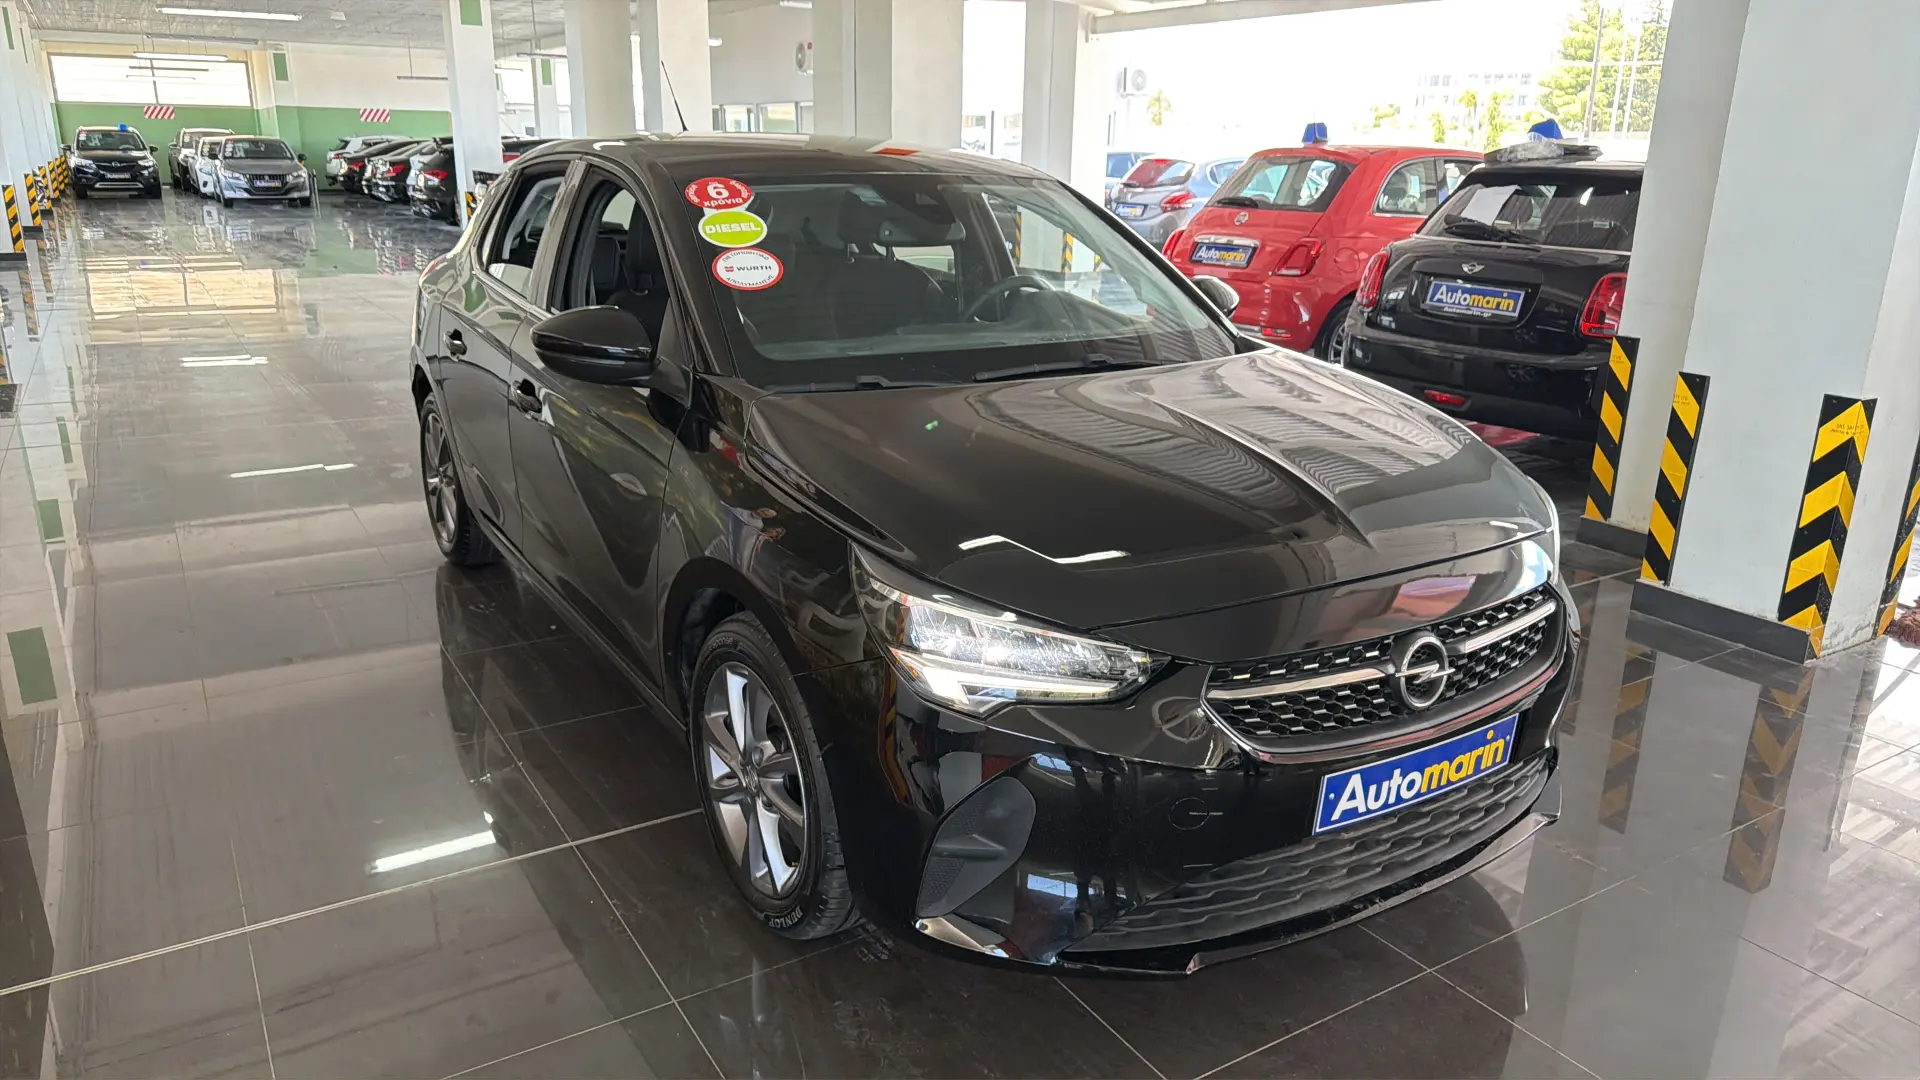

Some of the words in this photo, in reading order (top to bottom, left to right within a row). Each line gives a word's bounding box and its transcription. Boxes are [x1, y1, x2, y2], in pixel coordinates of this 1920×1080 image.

[707, 184, 729, 199] 6
[703, 197, 743, 207] χρόνια
[705, 222, 761, 234] DIESEL
[1197, 245, 1246, 261] Automarin
[1433, 284, 1515, 311] Automarin
[1443, 306, 1492, 317] Automarin.gr
[1331, 729, 1505, 821] Automarin
[768, 905, 803, 928] DUNLOP
